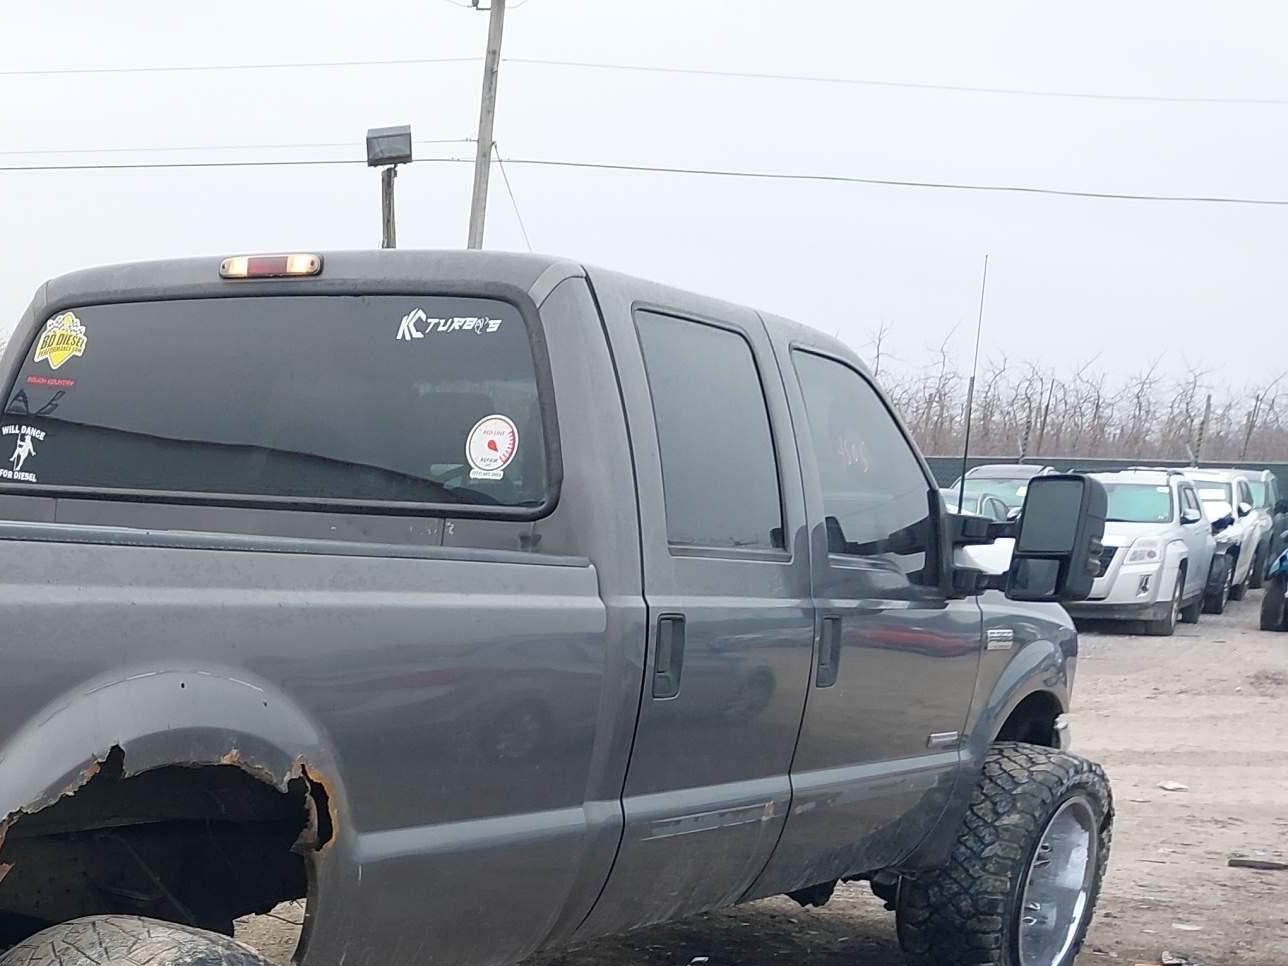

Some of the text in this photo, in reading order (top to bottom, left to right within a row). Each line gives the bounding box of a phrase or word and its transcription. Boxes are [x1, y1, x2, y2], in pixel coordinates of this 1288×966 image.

[56, 333, 86, 348] DIESEL
[2, 424, 46, 441] WILL DANCE
[13, 471, 38, 483] DIESEL
